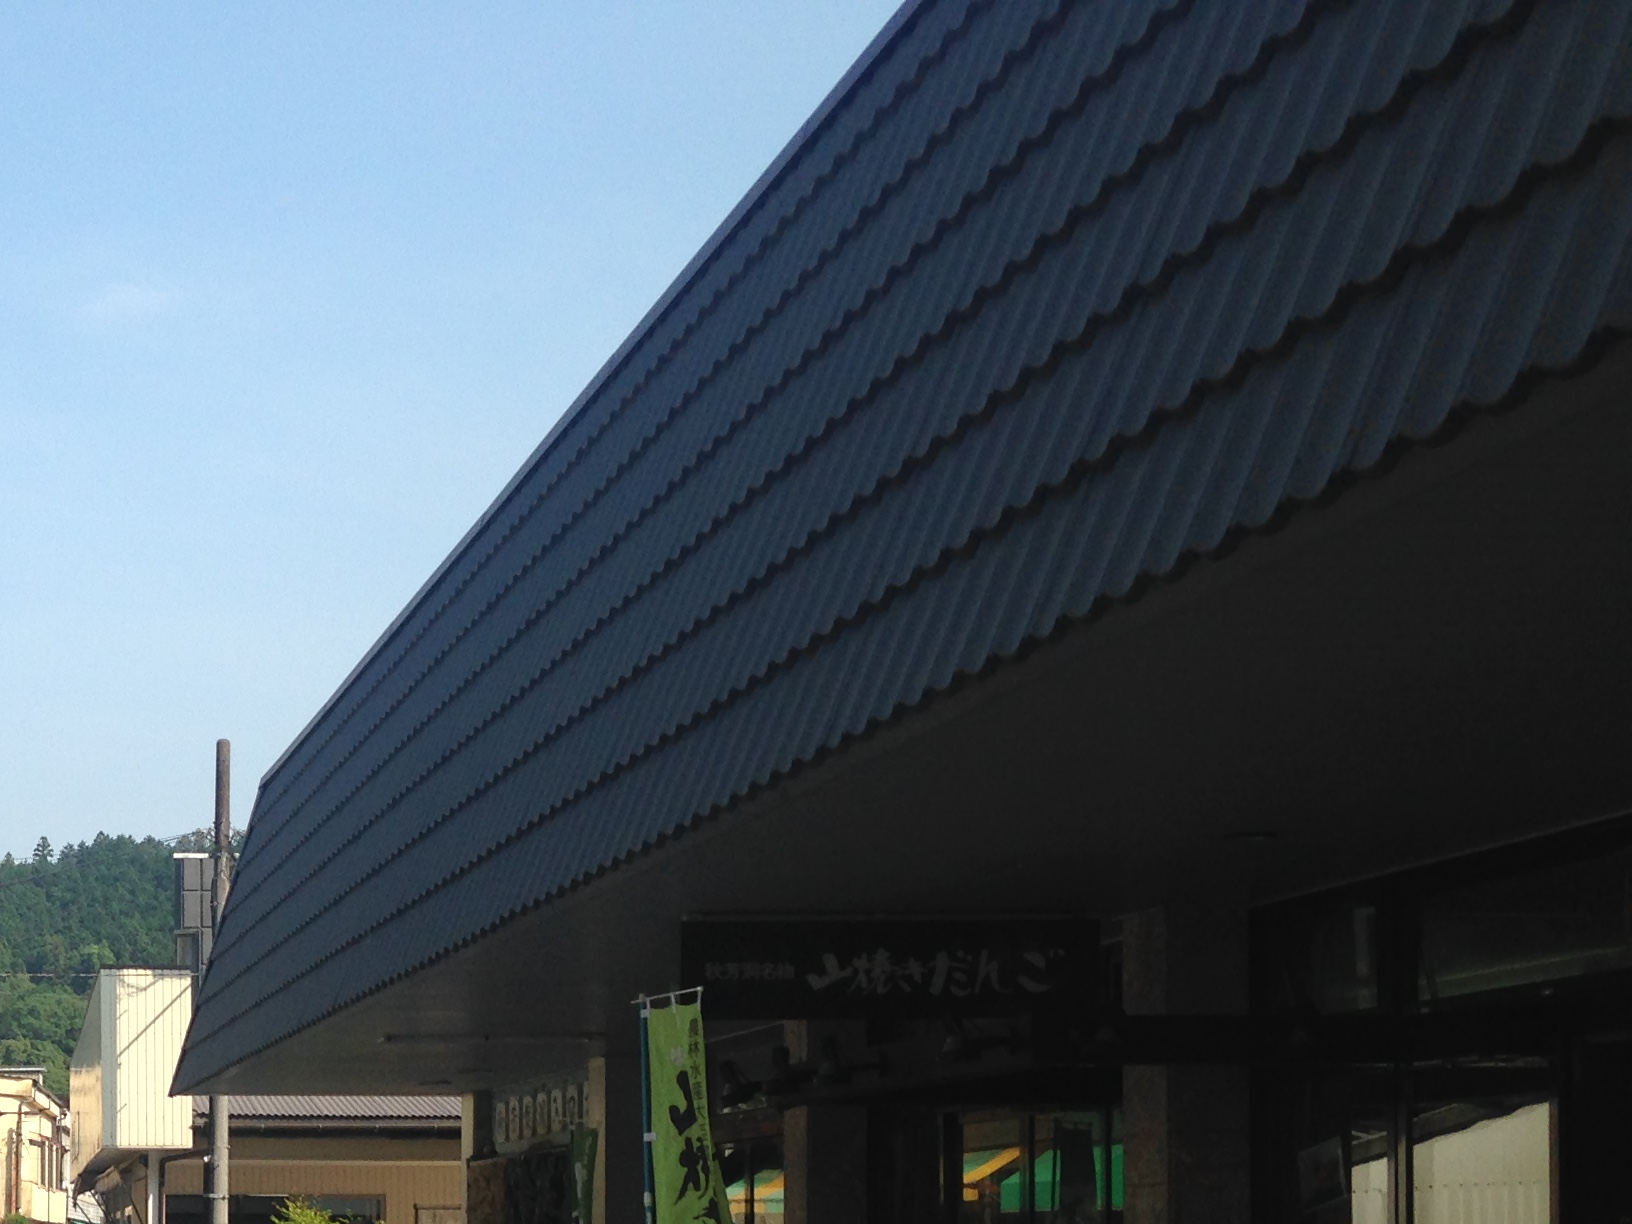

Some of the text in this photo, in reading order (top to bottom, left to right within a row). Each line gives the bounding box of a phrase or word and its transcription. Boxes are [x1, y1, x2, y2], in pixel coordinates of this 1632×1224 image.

[806, 947, 1066, 997] 山焼きだんご
